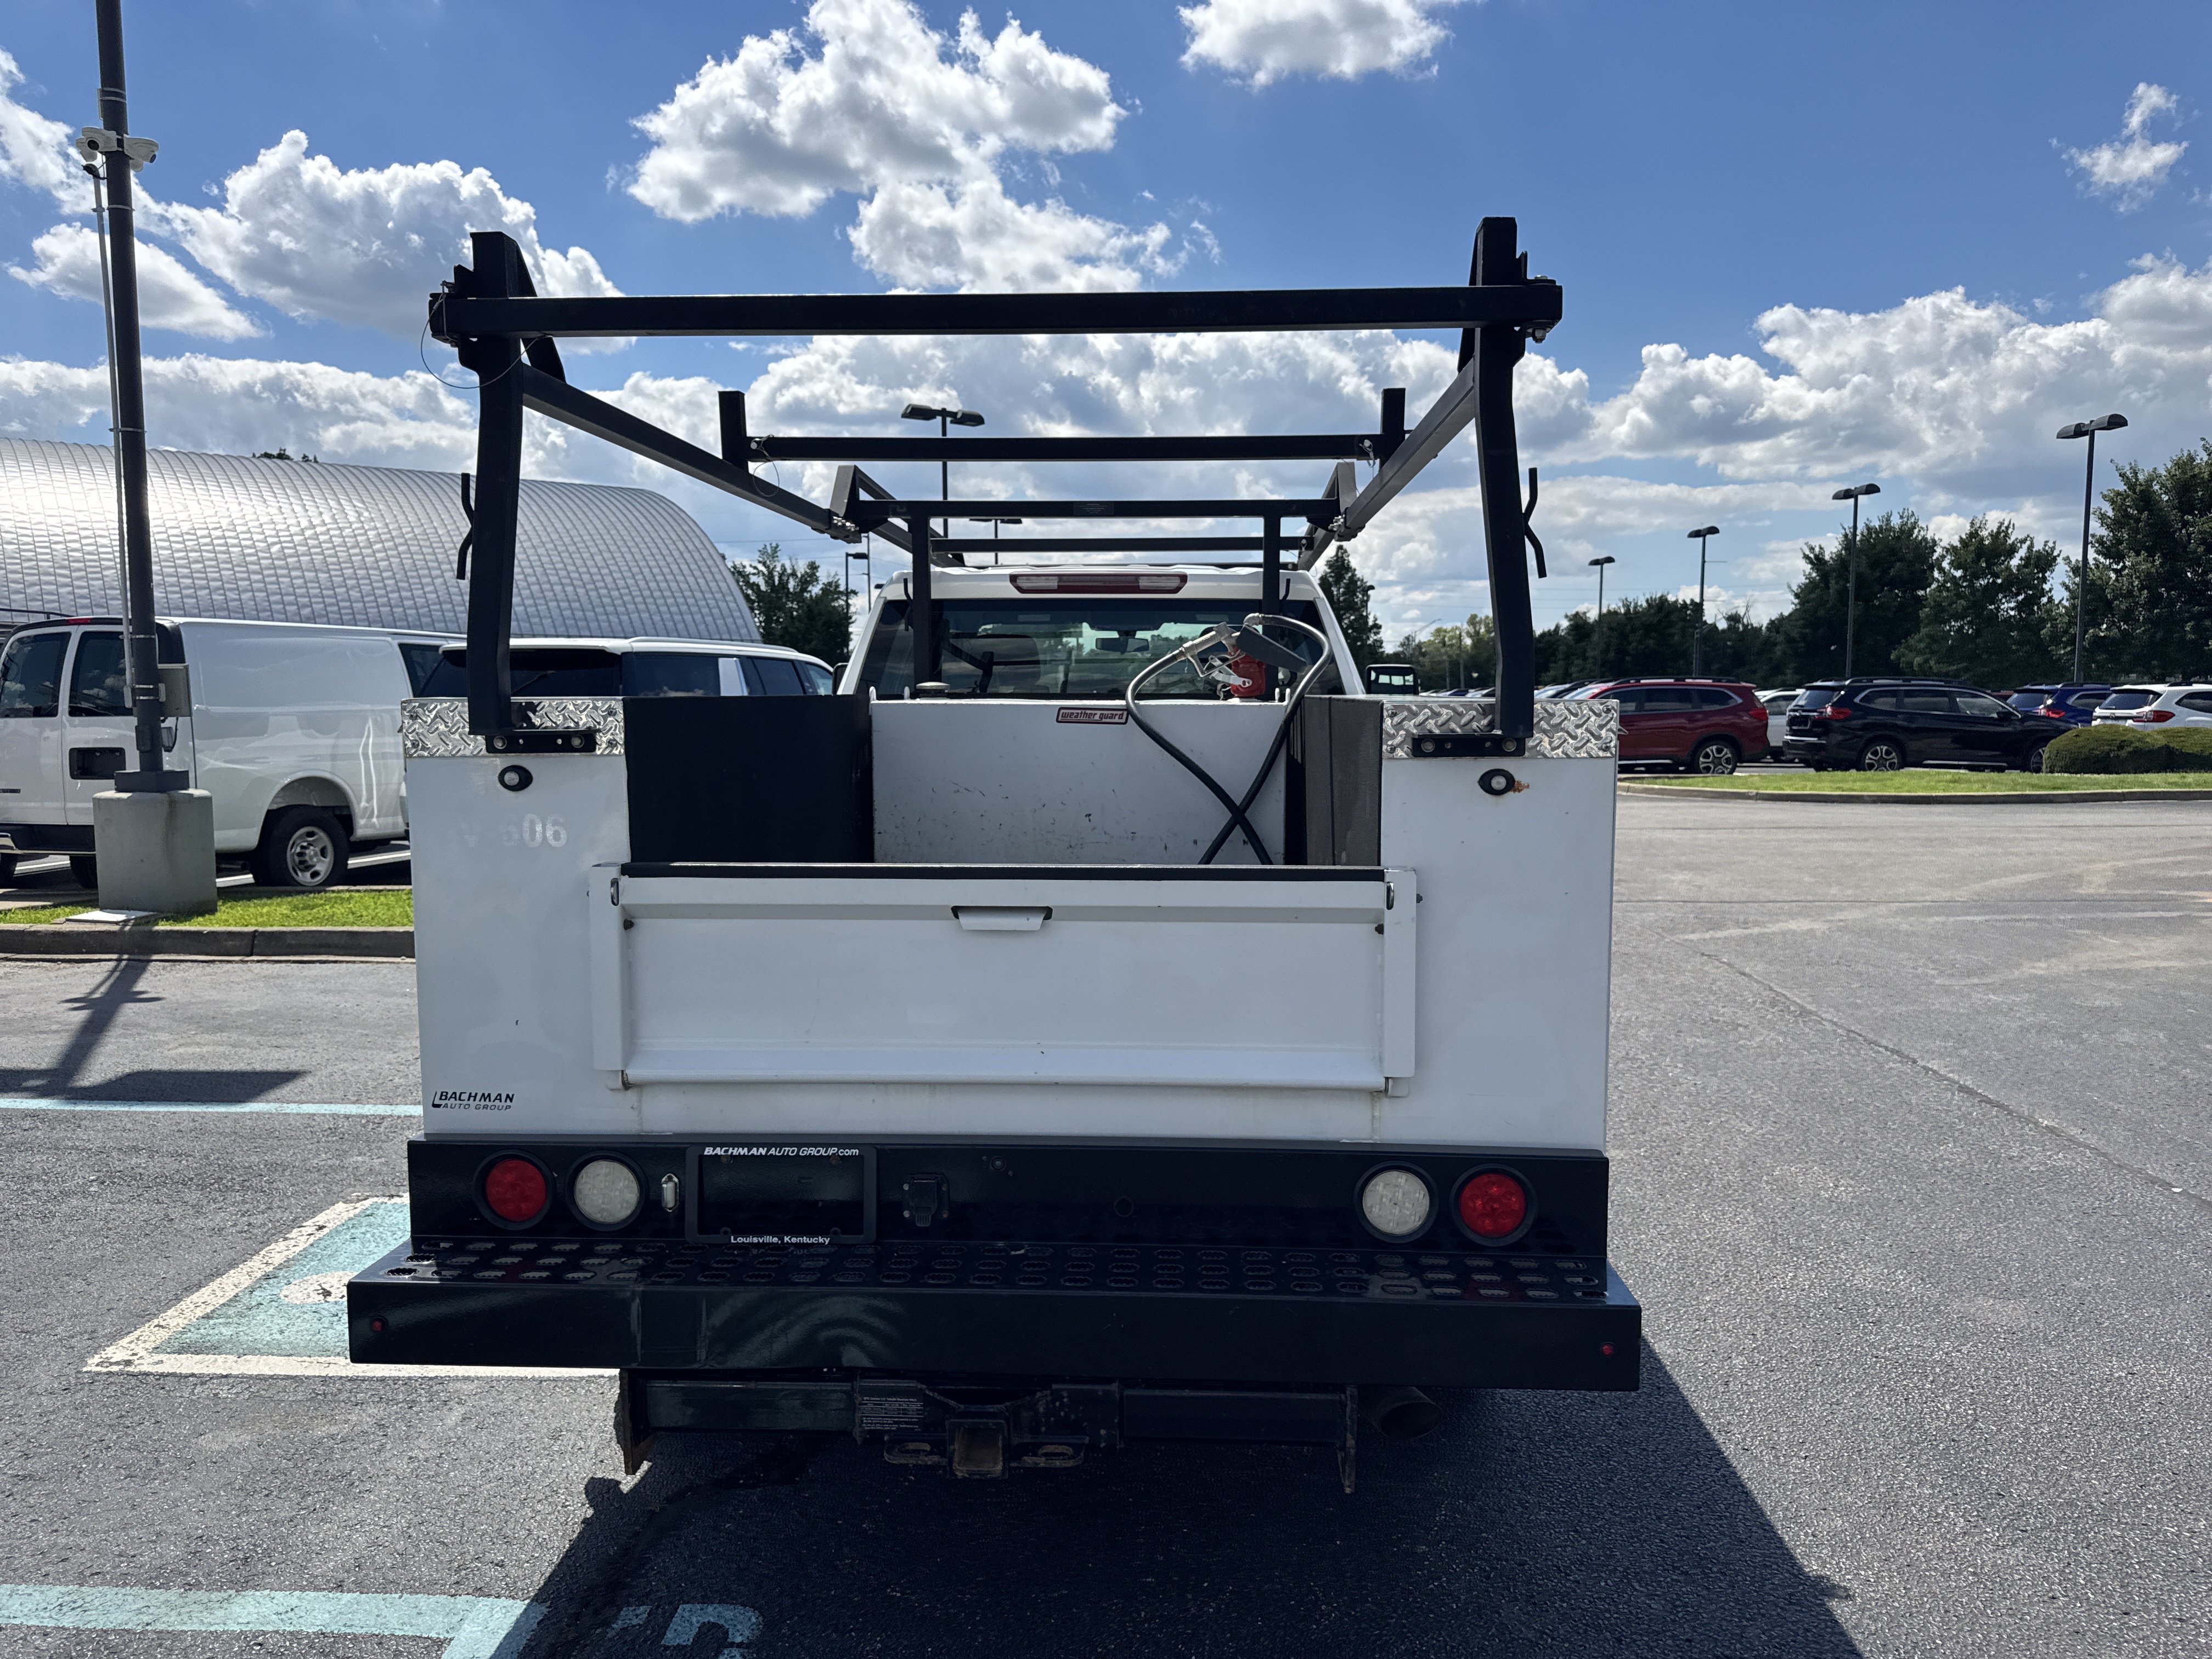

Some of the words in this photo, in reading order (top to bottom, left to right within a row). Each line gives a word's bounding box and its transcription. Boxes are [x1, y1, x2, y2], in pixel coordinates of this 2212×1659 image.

[1061, 710, 1098, 719] weather
[1099, 712, 1124, 721] guard
[438, 1091, 515, 1103] BACHMAN
[703, 1147, 767, 1155] BACHMAN
[768, 1147, 797, 1156] AUTO
[799, 1147, 859, 1156] GROUP.com
[731, 1235, 781, 1244] Louisville,
[783, 1235, 831, 1245] Kentucky
